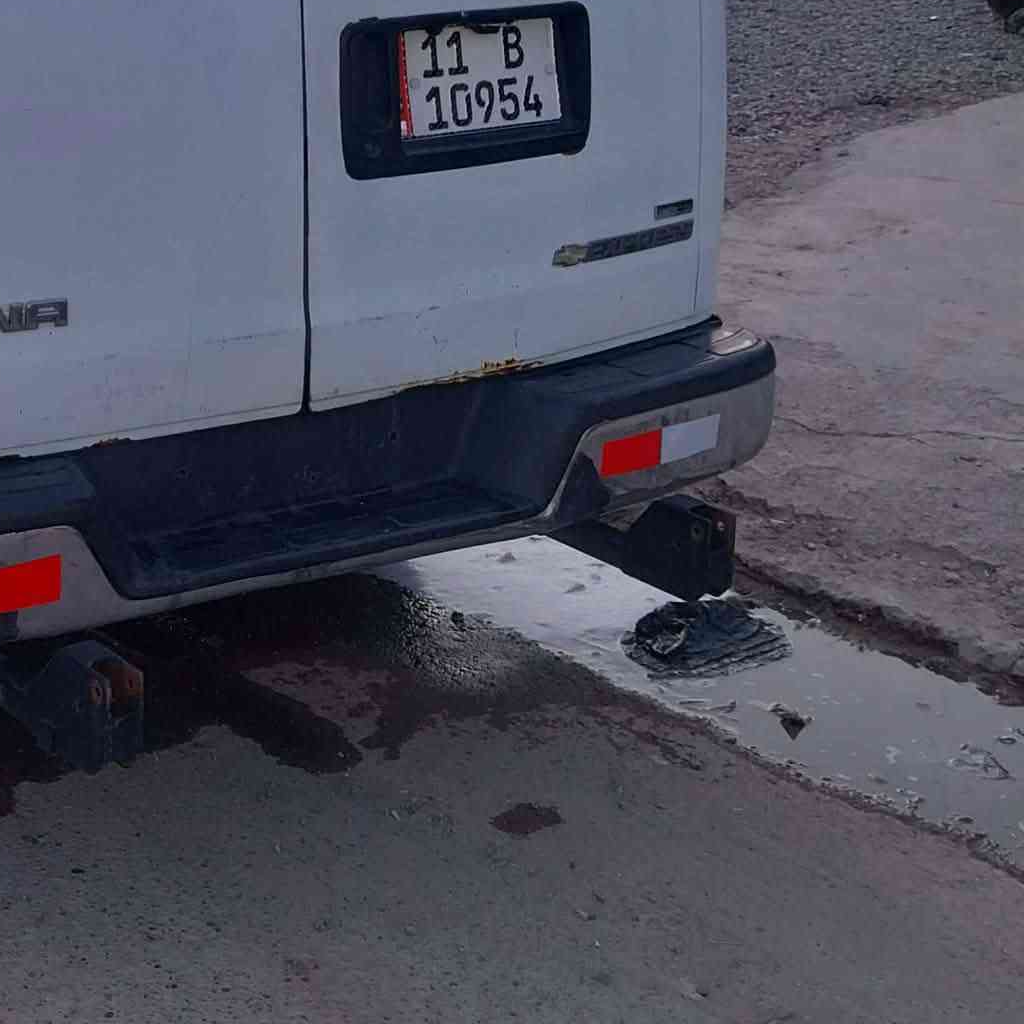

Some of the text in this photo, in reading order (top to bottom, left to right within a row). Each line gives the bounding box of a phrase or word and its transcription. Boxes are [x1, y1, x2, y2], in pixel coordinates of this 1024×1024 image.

[421, 25, 524, 78] 11 B
[426, 76, 543, 131] 10954
